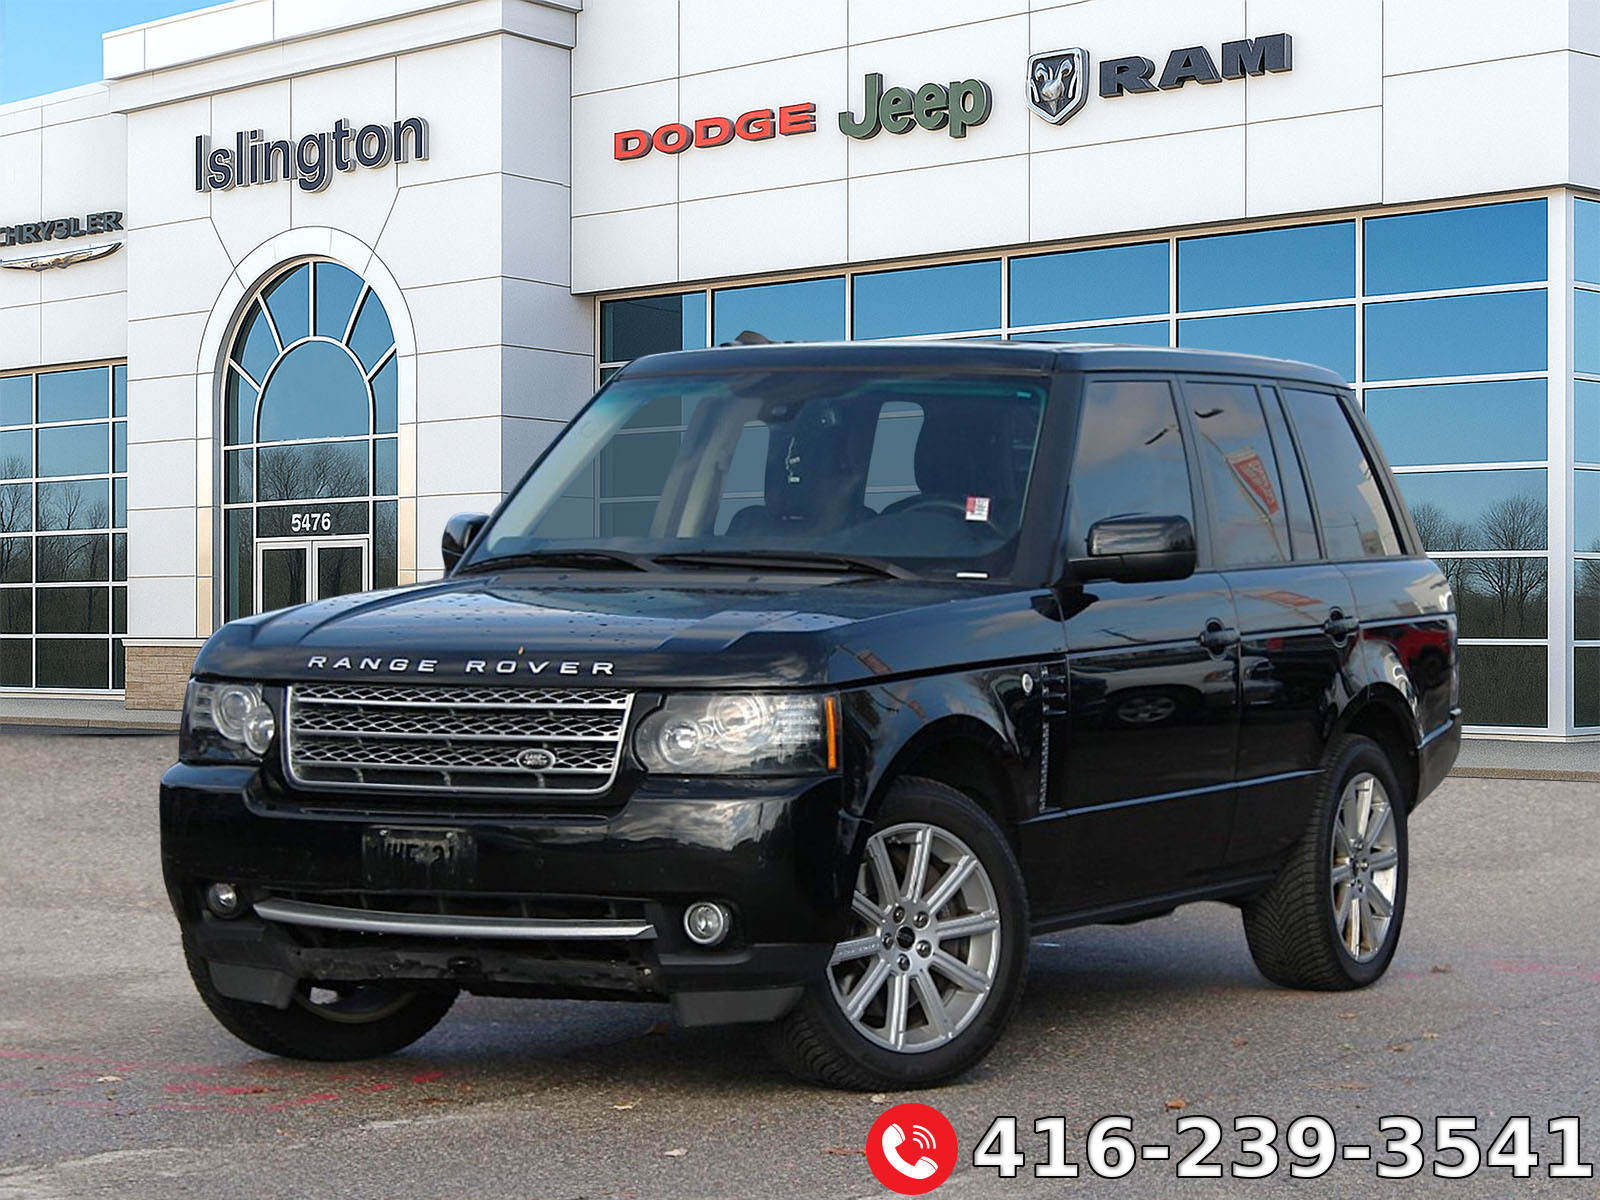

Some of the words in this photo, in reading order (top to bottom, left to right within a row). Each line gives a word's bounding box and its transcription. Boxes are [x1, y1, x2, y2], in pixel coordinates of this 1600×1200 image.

[1100, 33, 1293, 98] RAM
[614, 102, 817, 161] DODGE
[838, 73, 992, 140] Jeep
[195, 116, 429, 192] Islington
[291, 512, 332, 533] 5476
[307, 655, 439, 674] RANGE
[465, 660, 616, 677] ROVER
